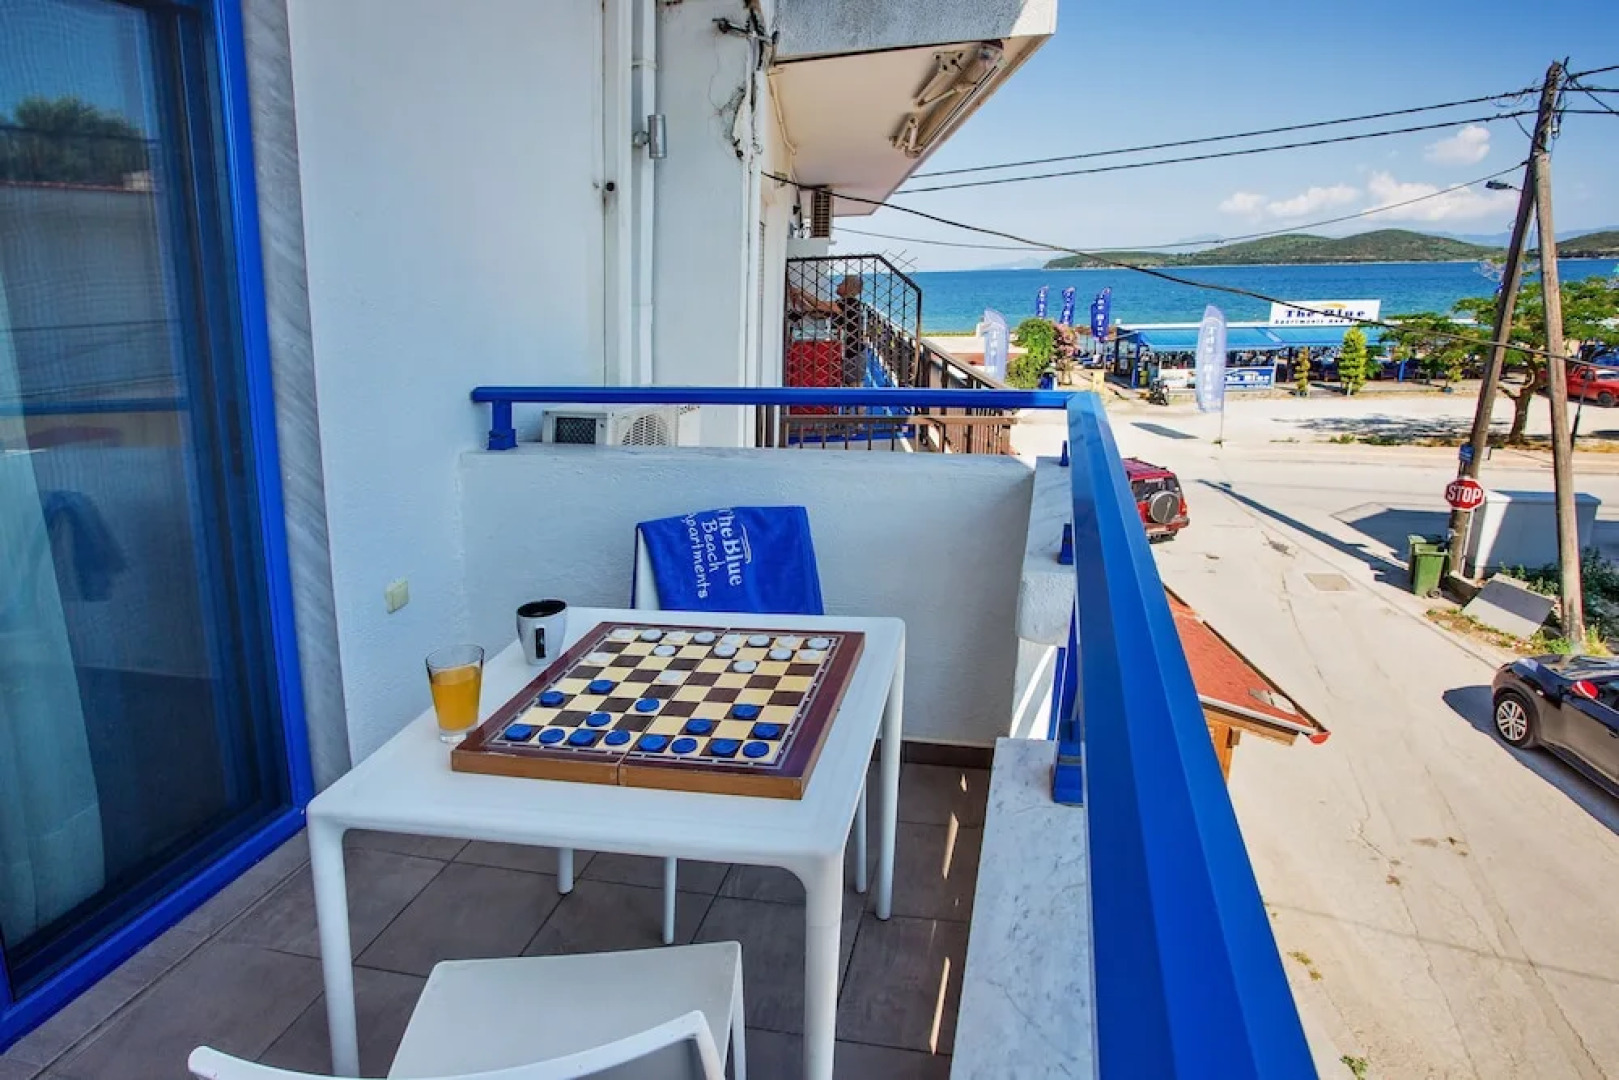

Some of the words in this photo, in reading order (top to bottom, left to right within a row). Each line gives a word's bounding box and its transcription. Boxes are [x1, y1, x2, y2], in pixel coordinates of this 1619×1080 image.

[1286, 309, 1314, 318] The
[1448, 485, 1482, 503] STOP
[718, 509, 735, 538] The
[702, 519, 725, 573] Beach
[722, 539, 743, 586] Blue
